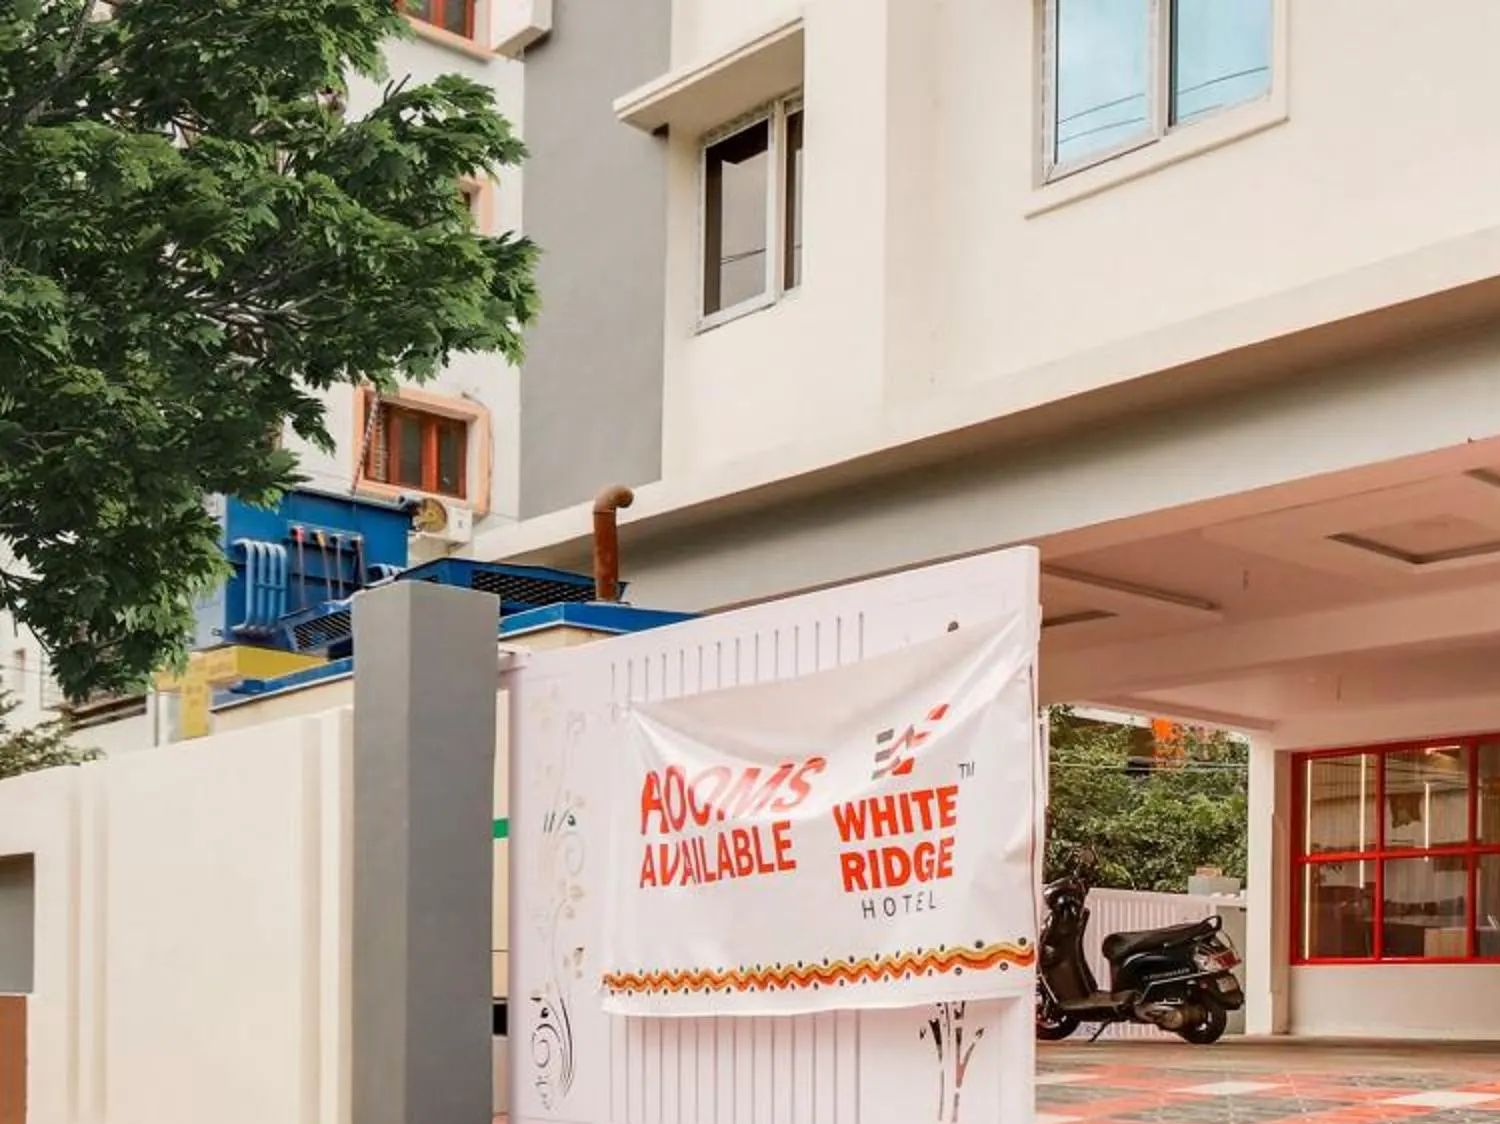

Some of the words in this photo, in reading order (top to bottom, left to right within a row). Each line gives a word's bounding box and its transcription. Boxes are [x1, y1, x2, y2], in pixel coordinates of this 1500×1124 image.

[832, 784, 959, 843] WHITE
[640, 820, 797, 889] AVAILABLE
[840, 836, 955, 893] RIDGE
[861, 890, 937, 919] HOTEL
